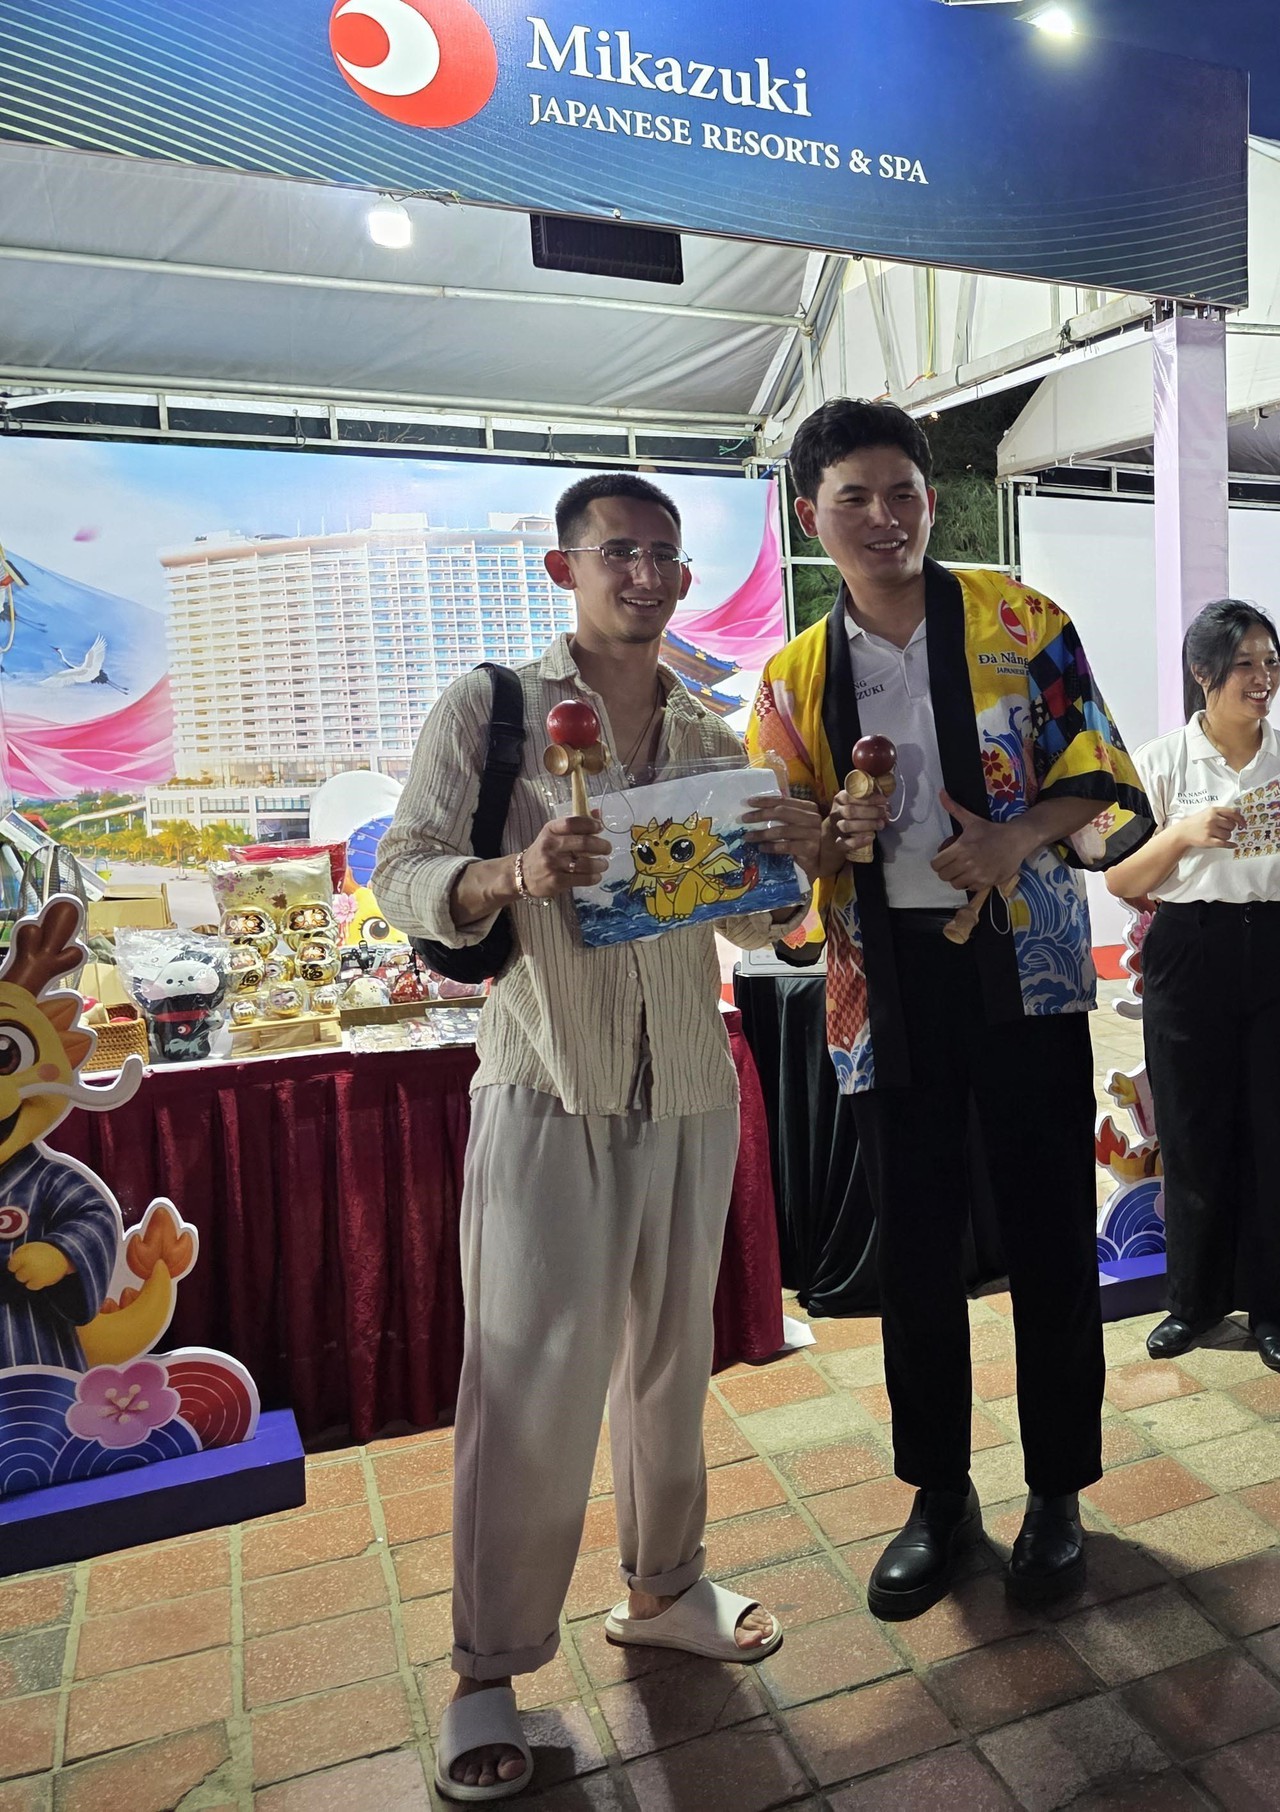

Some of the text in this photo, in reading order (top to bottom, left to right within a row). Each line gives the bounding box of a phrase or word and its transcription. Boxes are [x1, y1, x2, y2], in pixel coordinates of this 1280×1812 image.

[526, 16, 812, 118] Mikazuki
[528, 94, 929, 185] JAPANESE RESORTS & SPA
[978, 651, 1029, 669] Đà Nẵng
[856, 684, 885, 701] ZUKI
